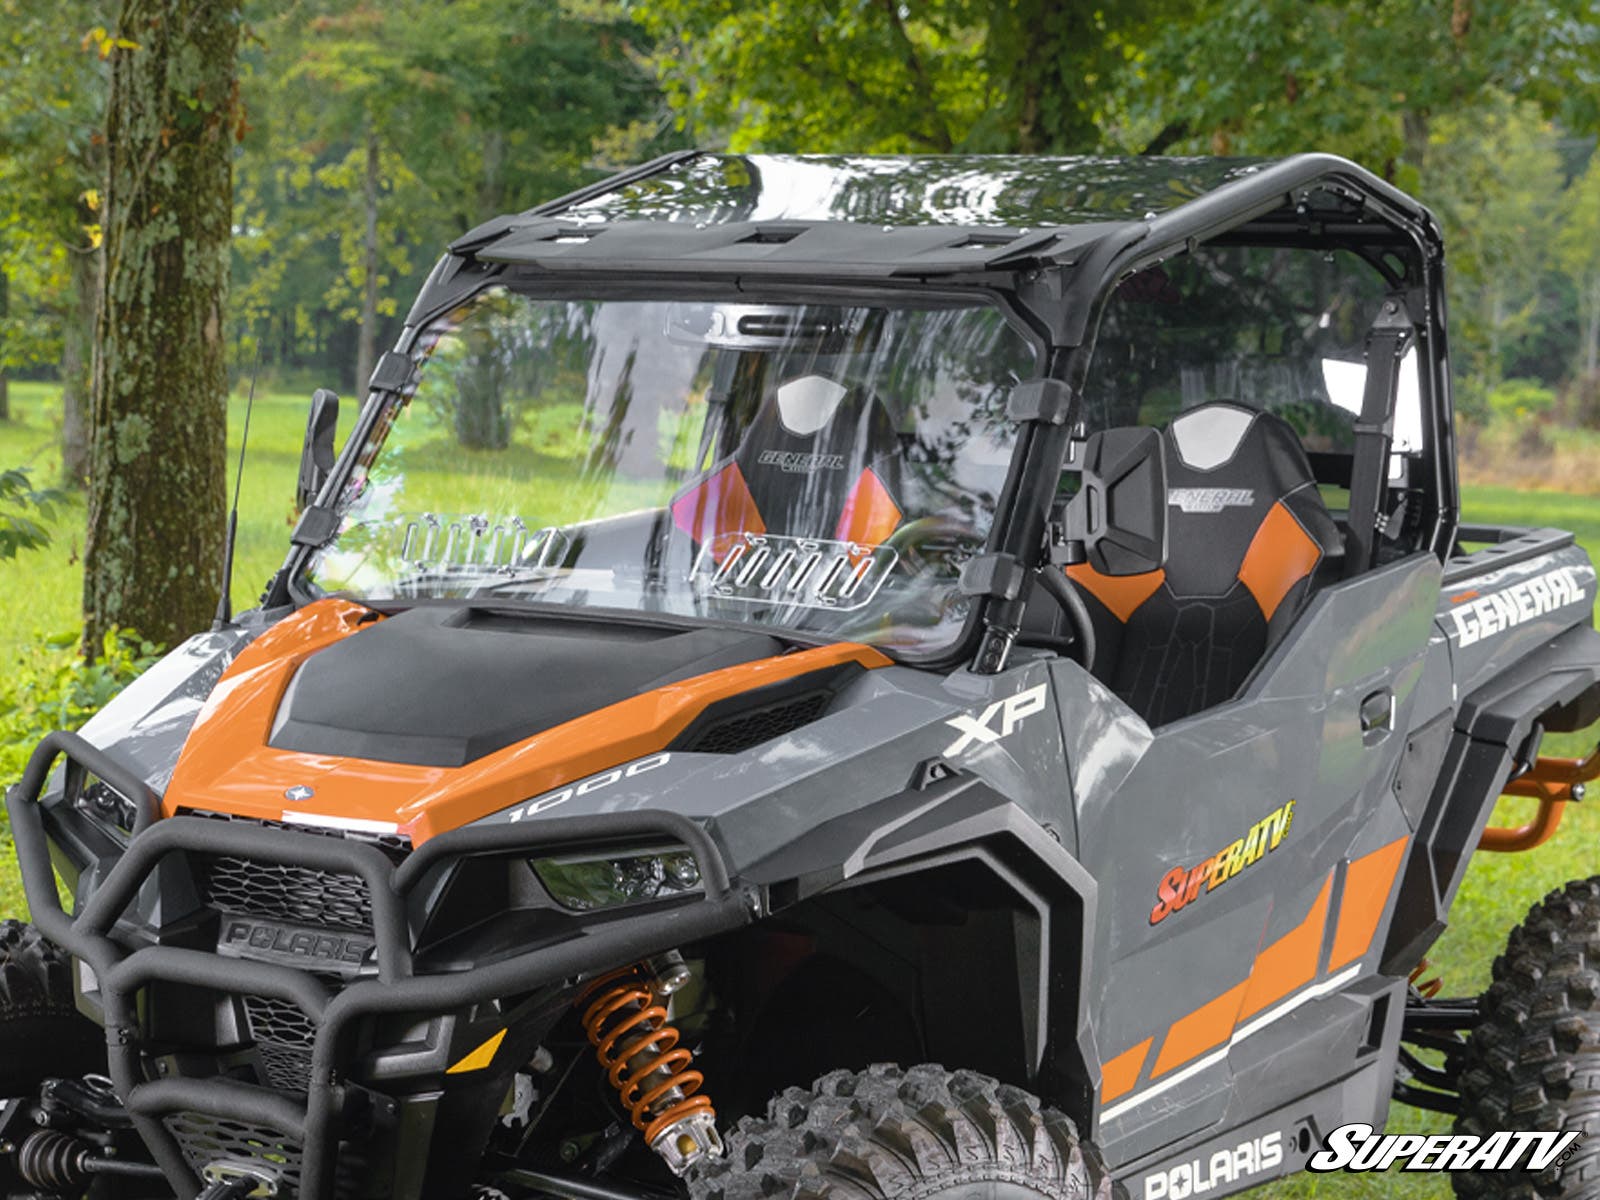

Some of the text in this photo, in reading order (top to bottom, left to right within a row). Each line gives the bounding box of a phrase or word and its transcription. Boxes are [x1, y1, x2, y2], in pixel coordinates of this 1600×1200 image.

[1167, 488, 1255, 506] ENERAL
[1450, 566, 1586, 648] GENERAL
[942, 682, 1047, 758] XP
[508, 752, 671, 824] 1000
[1149, 800, 1293, 926] SUPERATV
[226, 922, 370, 964] POLARIS
[1144, 1130, 1283, 1200] POLARIS
